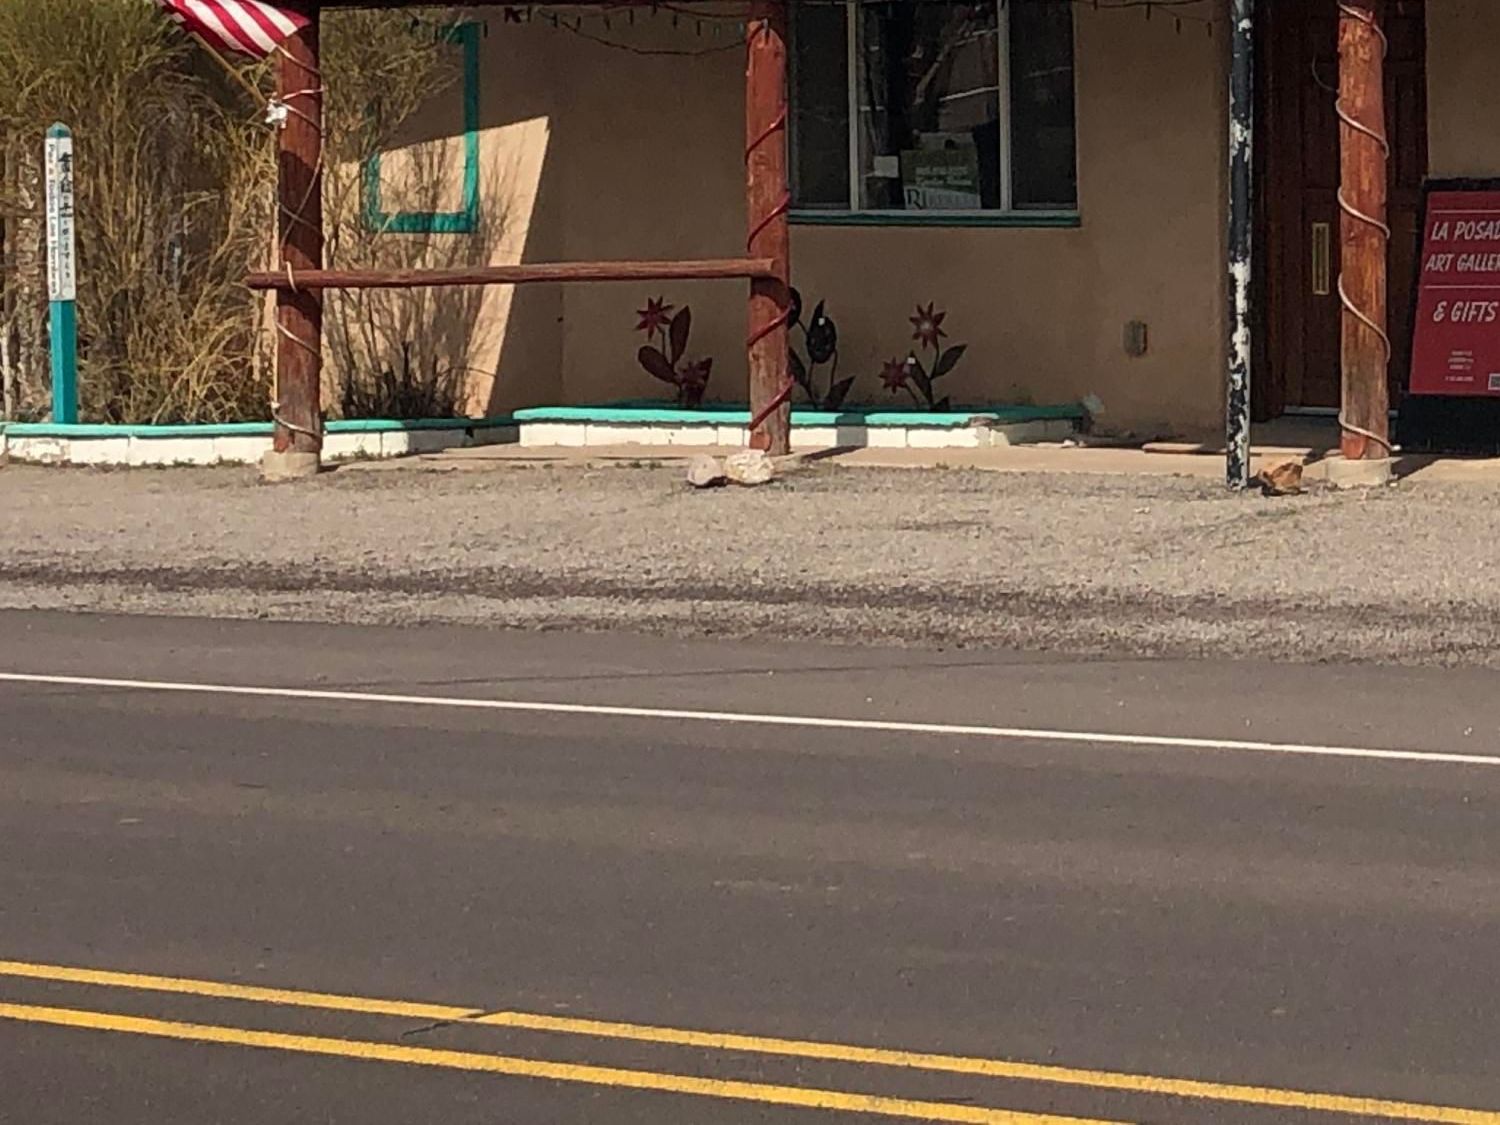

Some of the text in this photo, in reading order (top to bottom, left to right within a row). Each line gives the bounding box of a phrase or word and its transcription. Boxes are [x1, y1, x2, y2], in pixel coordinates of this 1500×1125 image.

[1430, 221, 1449, 241] LA
[1425, 253, 1454, 272] ART
[1433, 301, 1498, 322] & GIFTS
